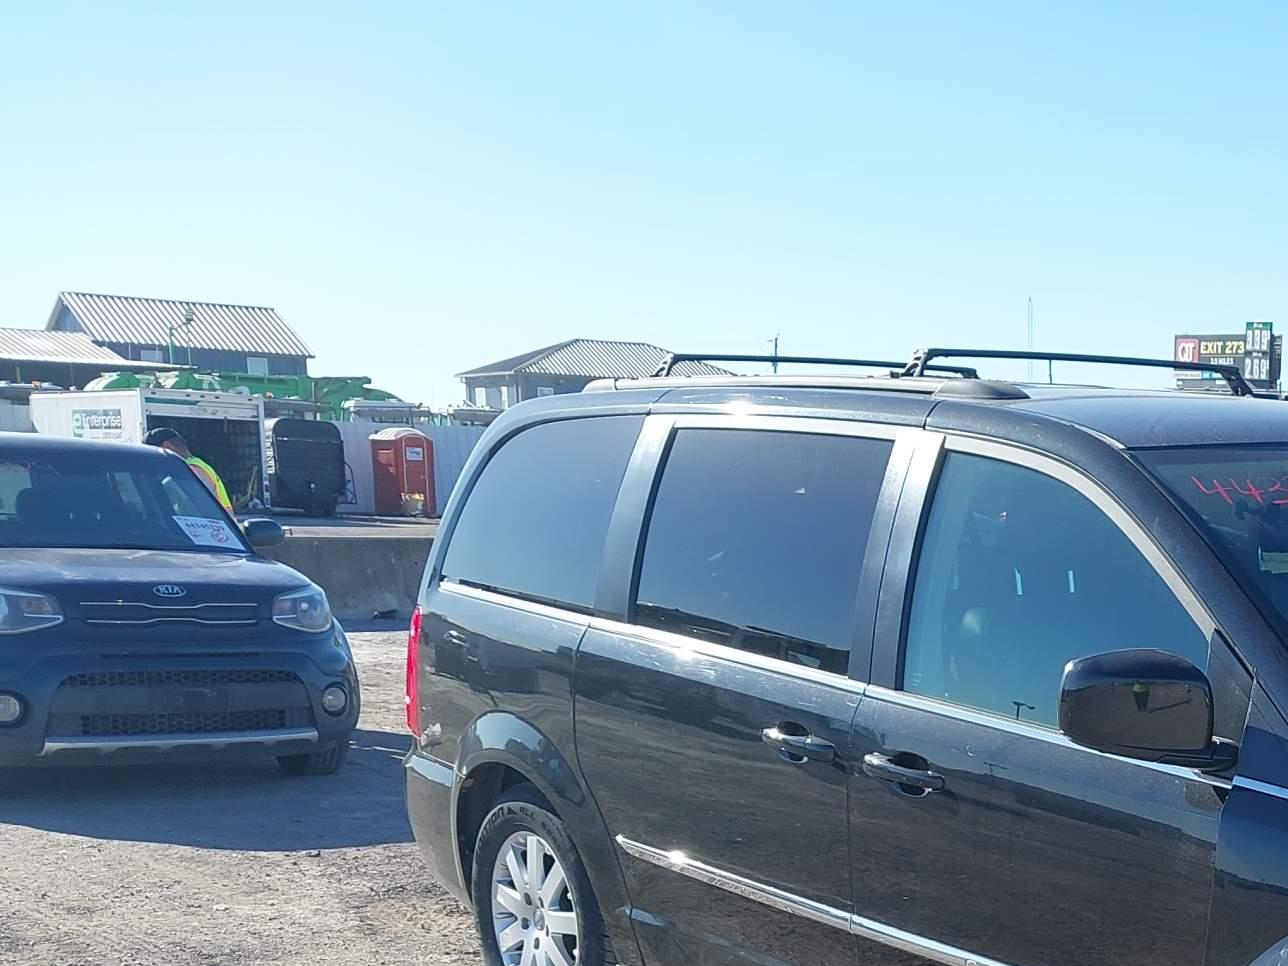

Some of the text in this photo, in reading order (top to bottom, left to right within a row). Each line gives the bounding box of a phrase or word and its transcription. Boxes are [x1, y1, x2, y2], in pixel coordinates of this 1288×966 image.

[1201, 341, 1245, 354] EXIT 273
[1219, 357, 1234, 365] MILES
[81, 411, 122, 429] Enterprise
[158, 585, 182, 595] KIA
